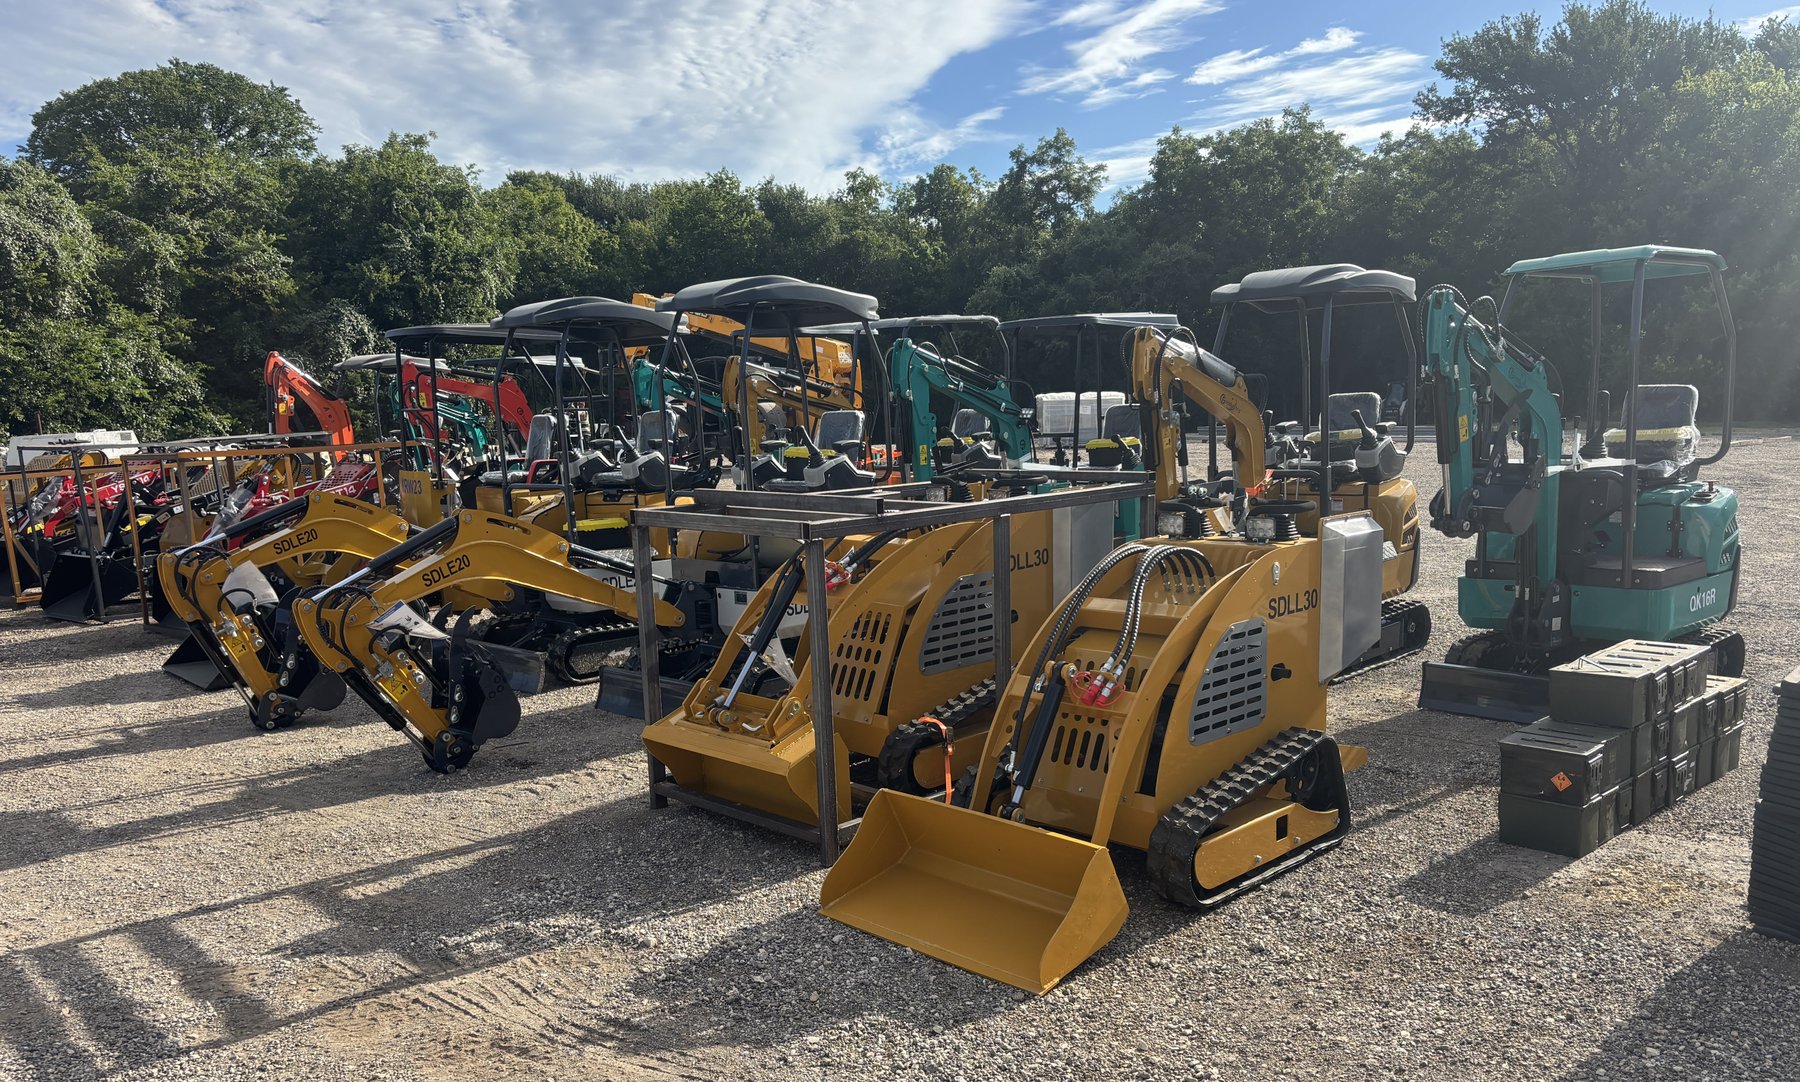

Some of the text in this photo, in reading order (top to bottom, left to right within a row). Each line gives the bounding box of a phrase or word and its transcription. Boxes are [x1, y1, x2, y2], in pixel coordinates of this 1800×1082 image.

[273, 528, 318, 555] SDLE20
[422, 554, 470, 587] SDLE20
[1010, 548, 1049, 572] DLL30
[602, 576, 636, 589] DLE
[787, 603, 809, 616] SDL
[1268, 588, 1318, 619] SDLL30
[1690, 588, 1716, 612] QK16R
